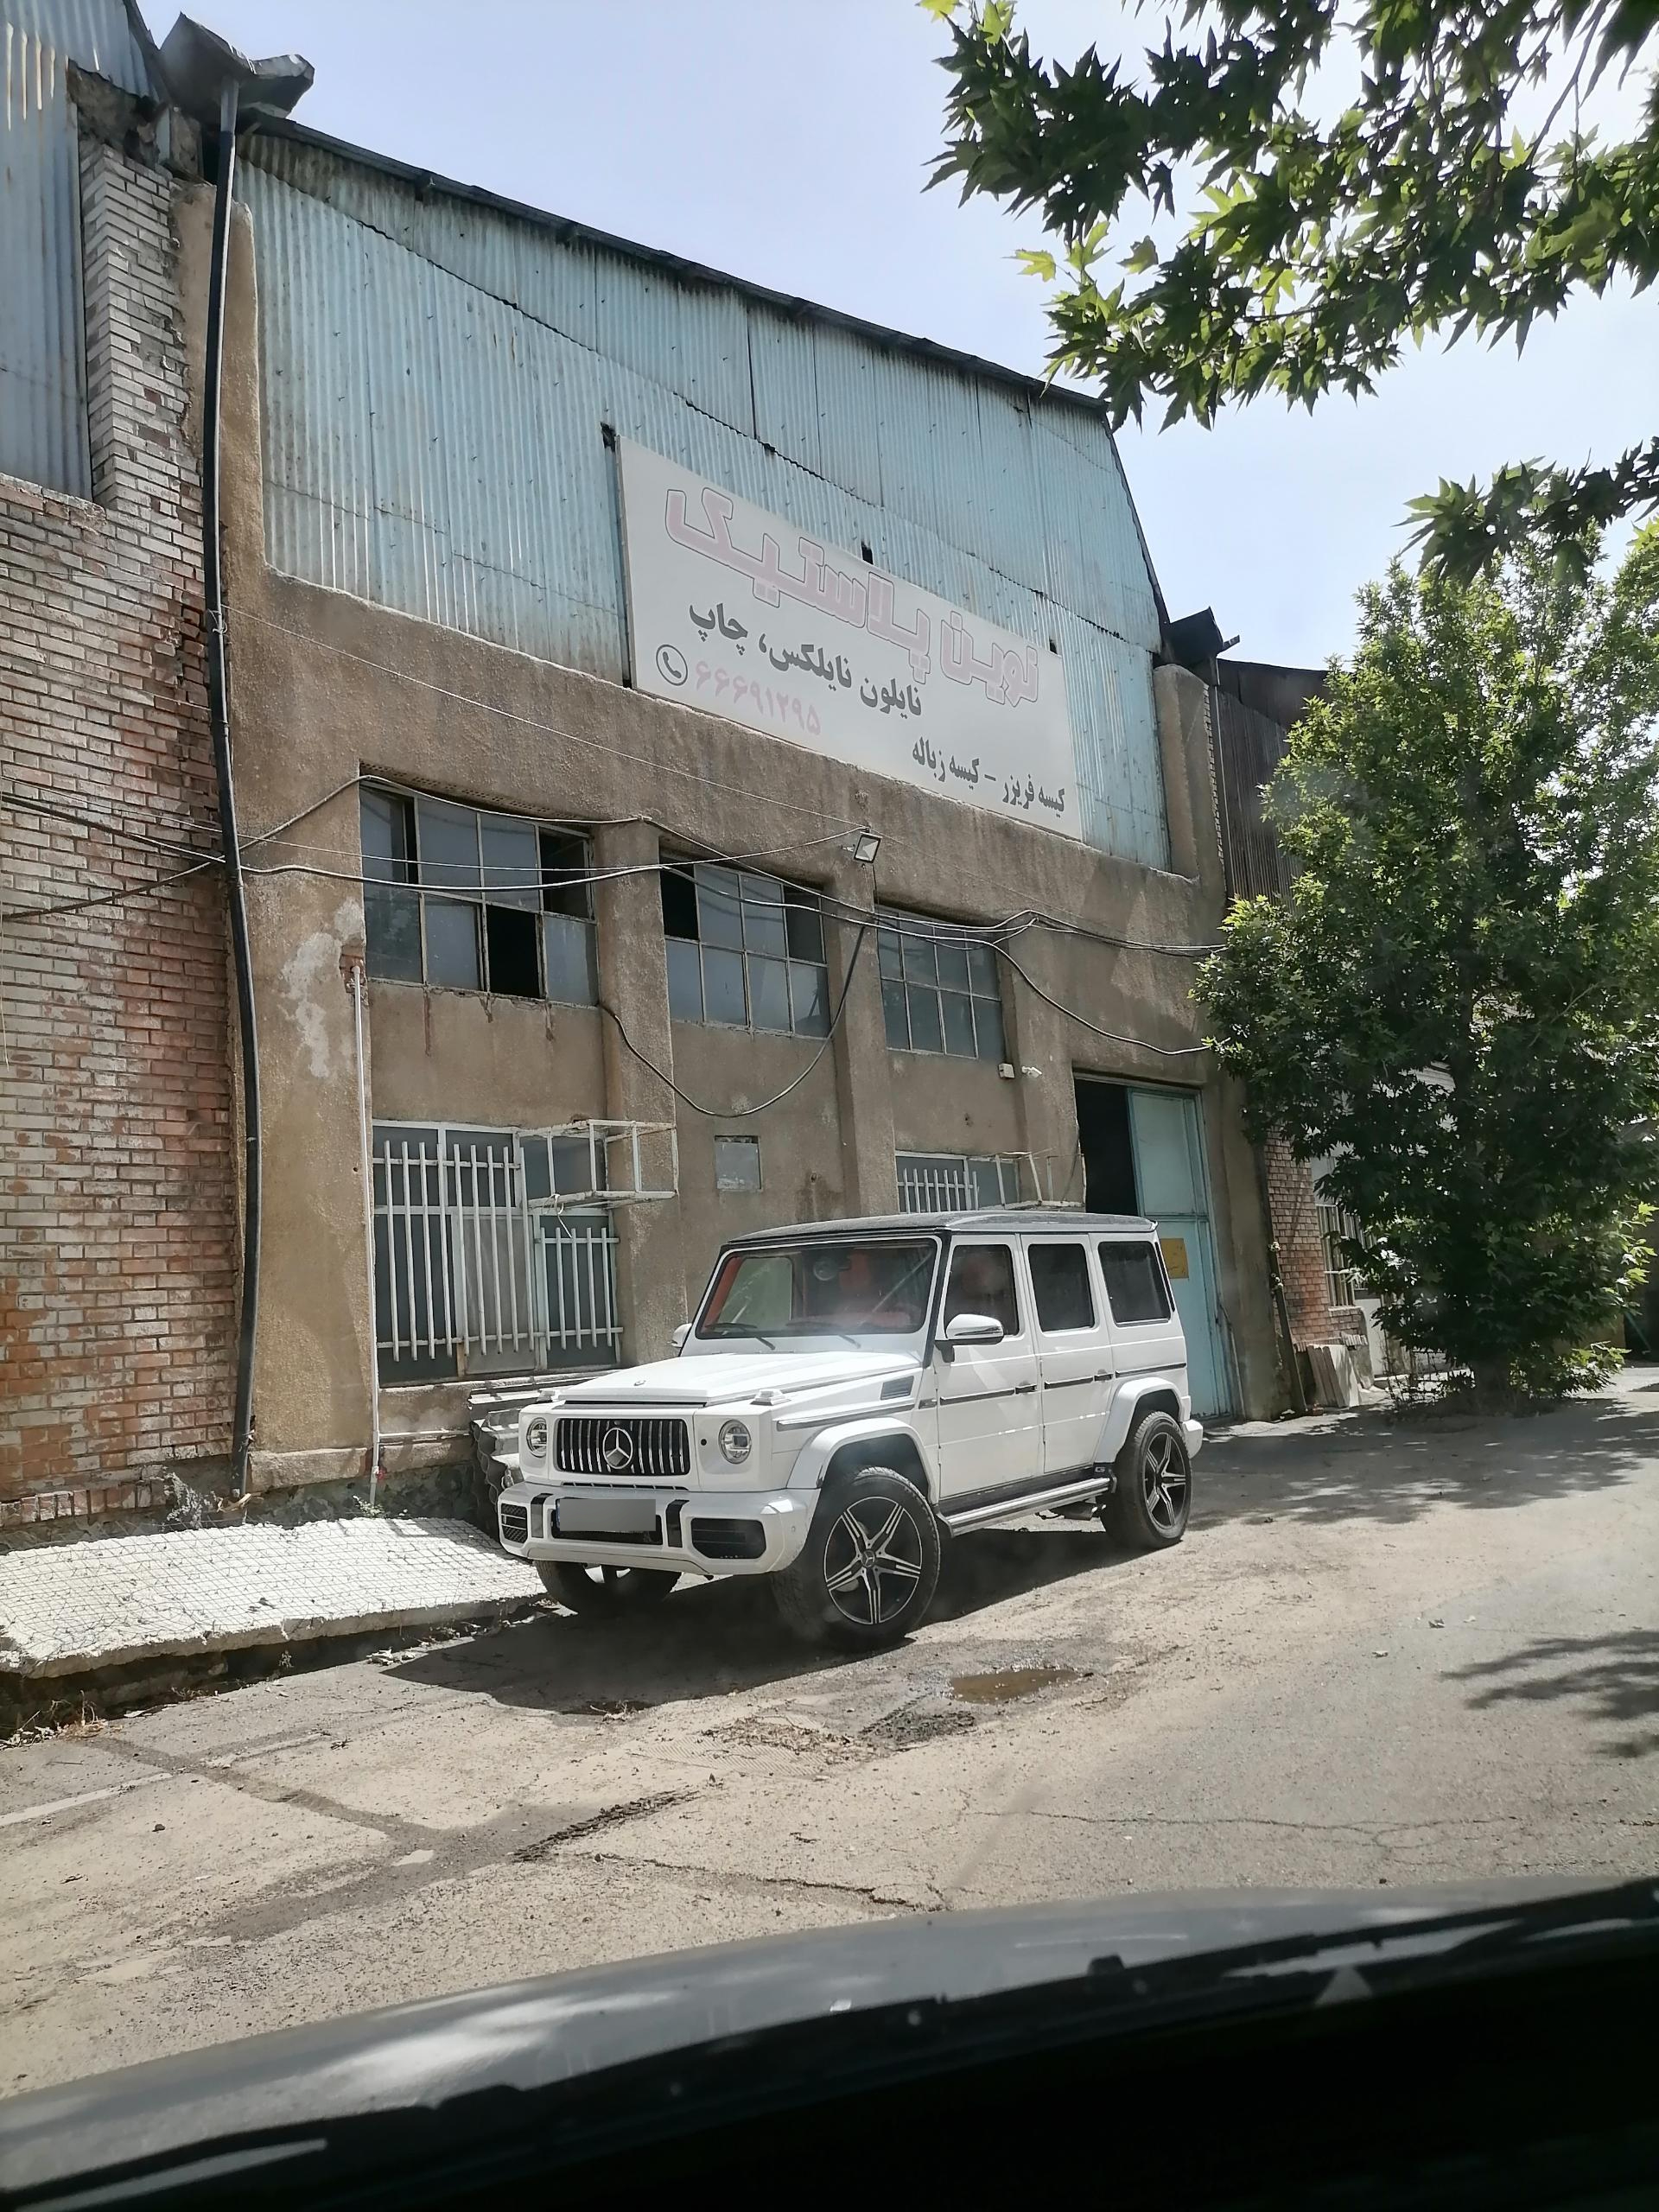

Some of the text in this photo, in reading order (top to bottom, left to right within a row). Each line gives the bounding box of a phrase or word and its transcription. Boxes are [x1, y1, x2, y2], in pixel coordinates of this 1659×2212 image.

[664, 486, 1038, 708] نوین پلاستیک
[690, 602, 749, 656] چاپ
[860, 677, 922, 719] نایلون
[912, 736, 946, 782] زباله
[949, 754, 980, 791] کیسه
[1002, 773, 1035, 810] فریزر
[1039, 786, 1065, 818] کیسه
